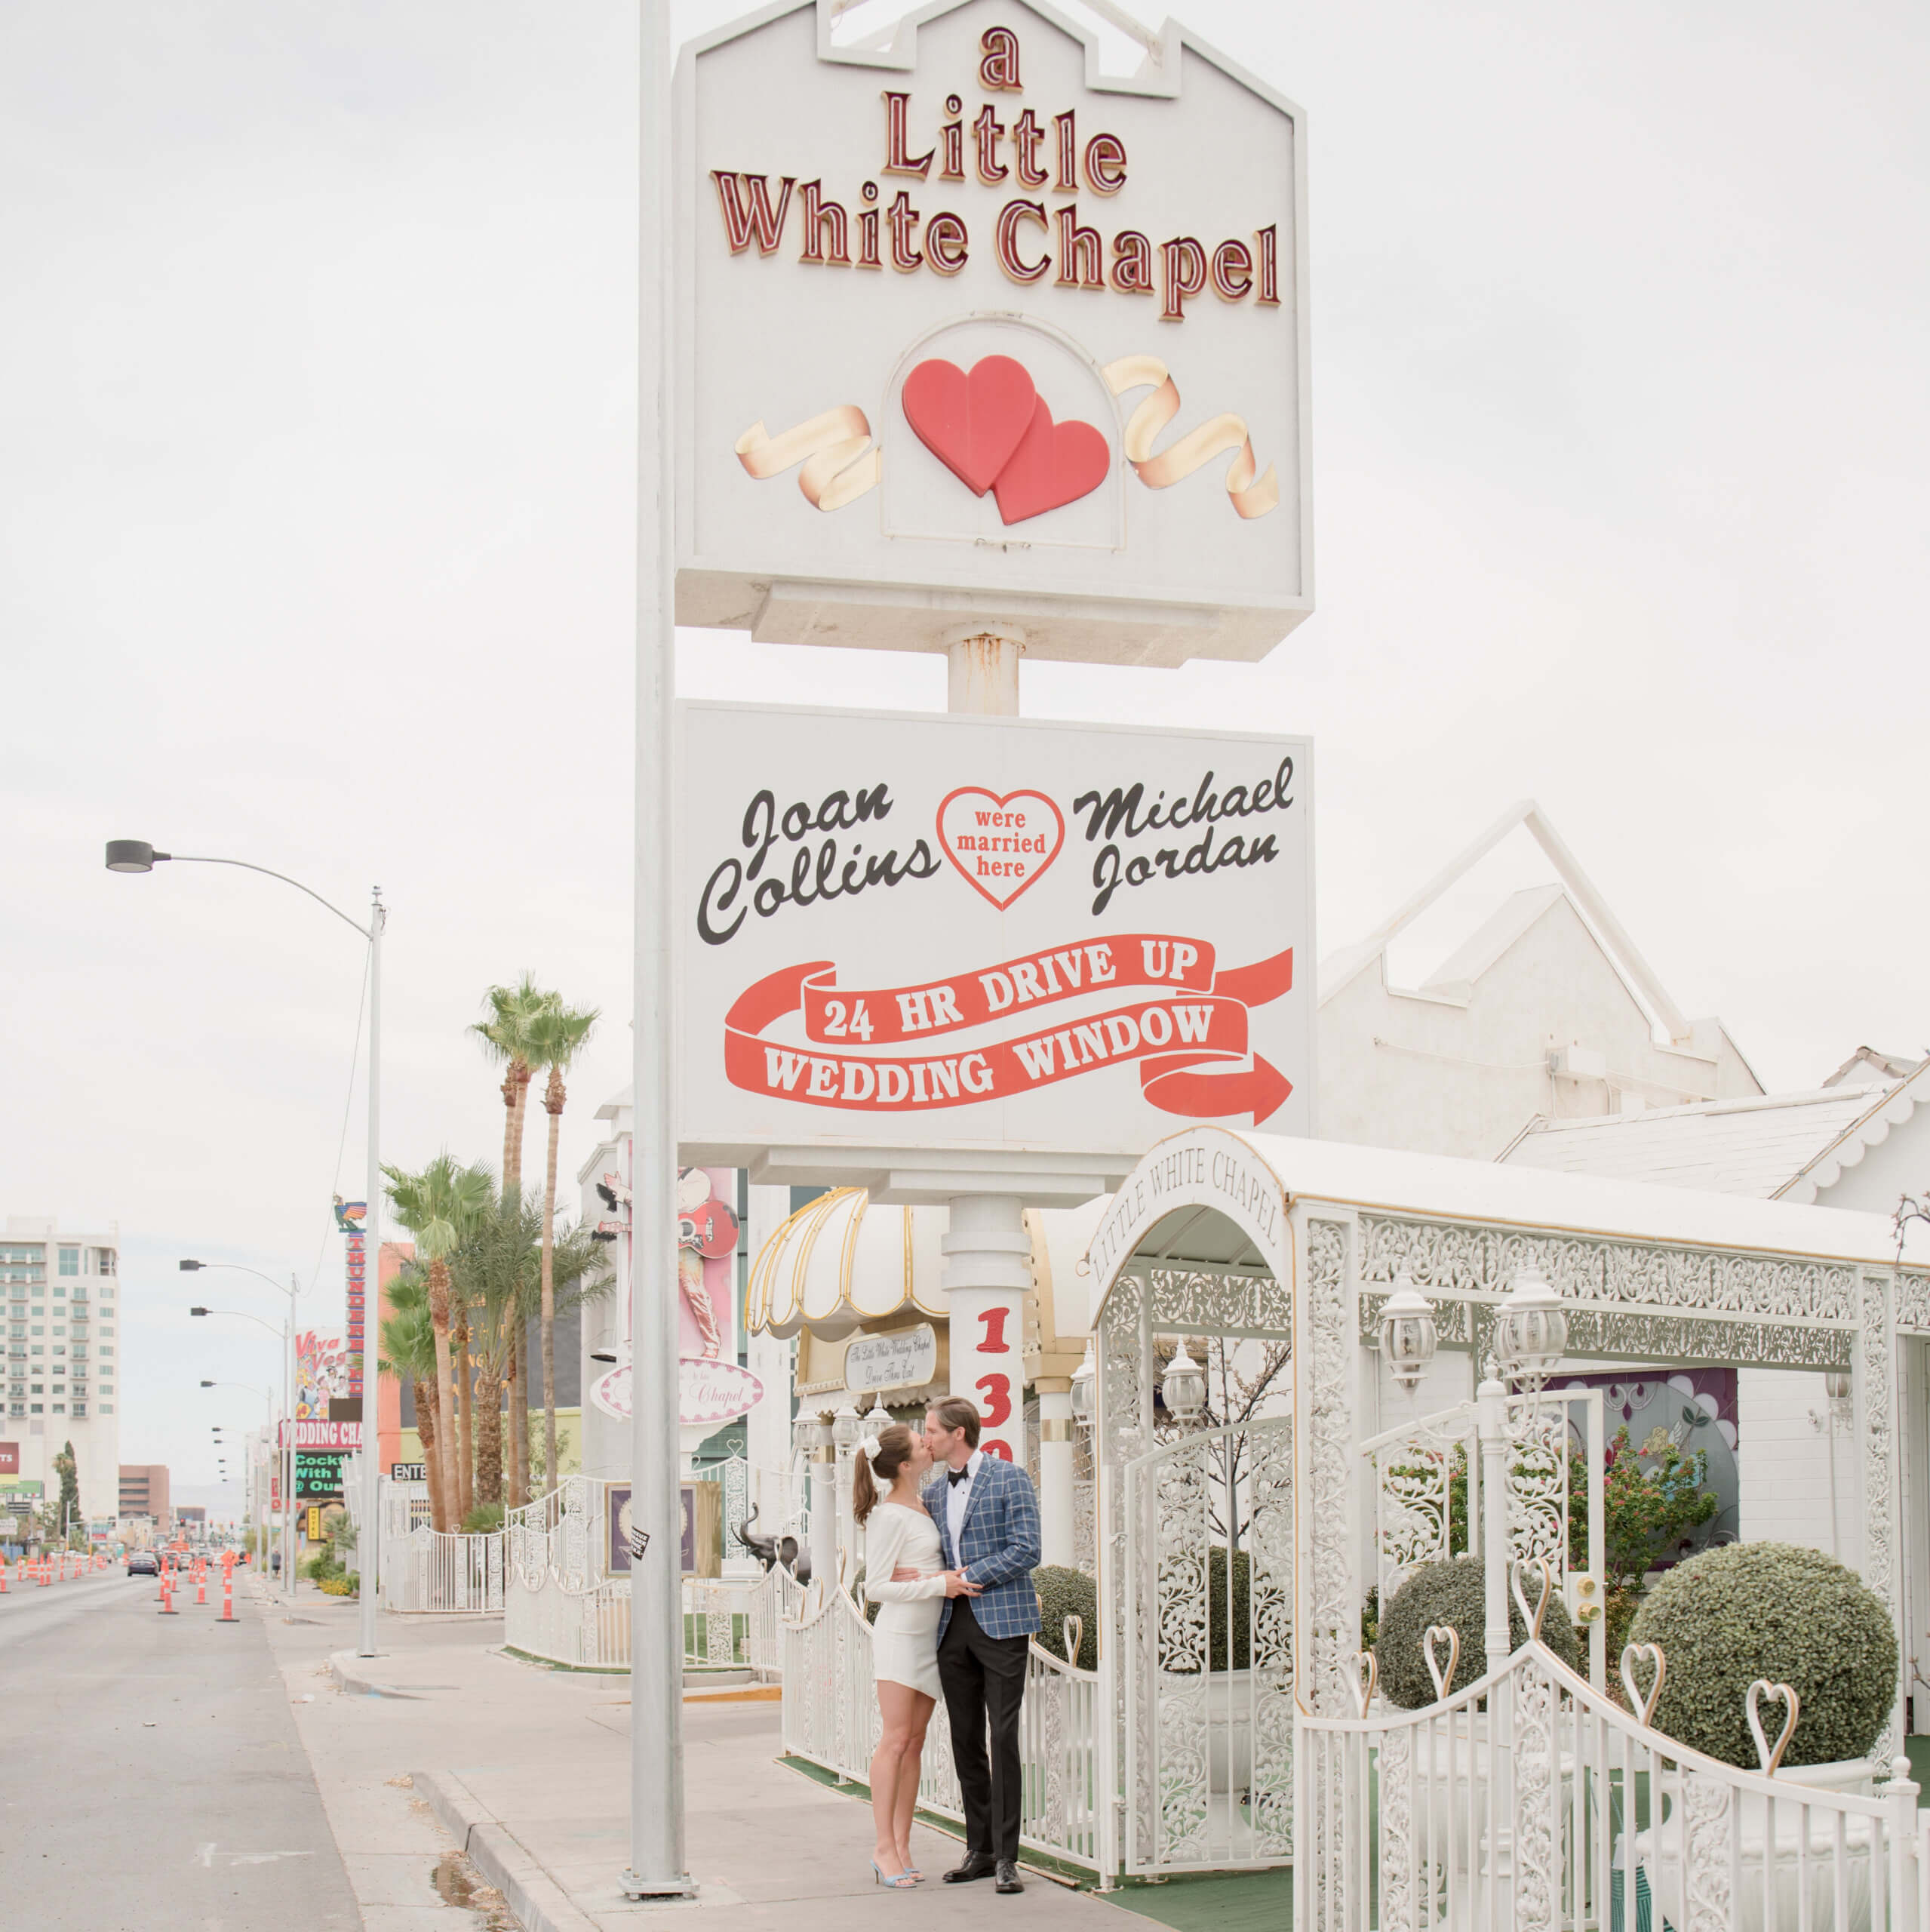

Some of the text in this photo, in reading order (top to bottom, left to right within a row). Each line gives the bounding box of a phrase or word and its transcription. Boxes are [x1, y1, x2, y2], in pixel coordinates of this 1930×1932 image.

[979, 26, 1023, 92] a
[881, 91, 1127, 196] Little
[711, 169, 1281, 322] White Chapel
[742, 782, 893, 878] Joan
[956, 832, 1047, 854] married
[974, 810, 1026, 829] were
[1073, 756, 1294, 842] Michael
[696, 838, 941, 945] Collins
[976, 856, 1025, 878] here
[1091, 826, 1280, 915] Jordan
[823, 940, 1198, 1042] 24 HR DRIVE UP
[764, 1004, 1215, 1103] WEDDING WINDOW
[1093, 1148, 1277, 1286] LITTLE WHITE CHAPEL
[690, 1382, 744, 1407] Chapel
